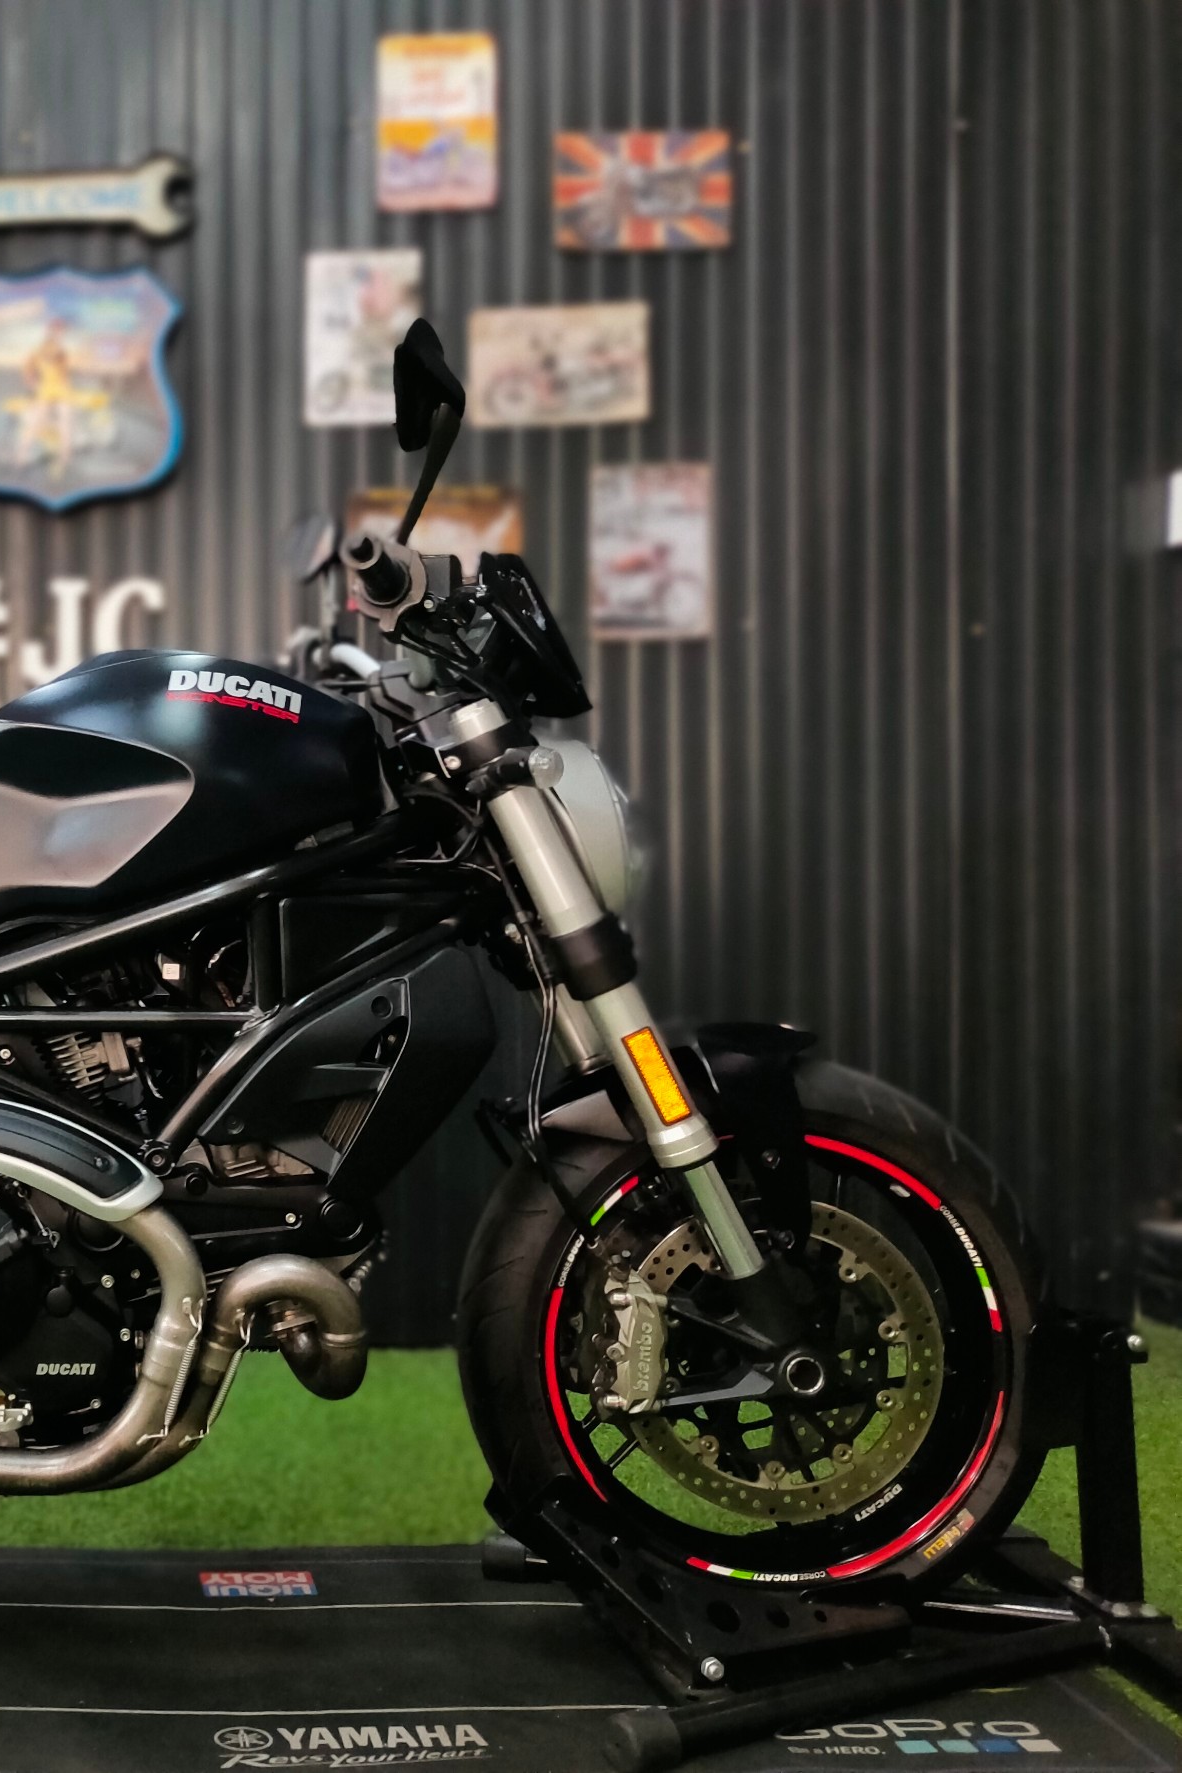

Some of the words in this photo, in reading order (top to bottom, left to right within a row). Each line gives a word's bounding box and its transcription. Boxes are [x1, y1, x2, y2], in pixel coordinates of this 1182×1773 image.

[167, 670, 302, 714] DUCATI
[165, 691, 300, 724] MONSTER
[955, 1227, 983, 1267] DUCATI
[35, 1363, 96, 1376] DUCATI
[633, 1322, 653, 1392] brembo
[854, 1483, 903, 1522] DUCATI
[923, 1525, 961, 1559] PIRELLI
[206, 1572, 308, 1584] MOLY
[209, 1584, 312, 1597] LIQUI
[752, 1573, 799, 1582] DUCATI
[276, 1724, 489, 1749] YAMAHA
[219, 1753, 324, 1769] Revs
[329, 1752, 403, 1768] Your
[404, 1748, 488, 1760] Heart
